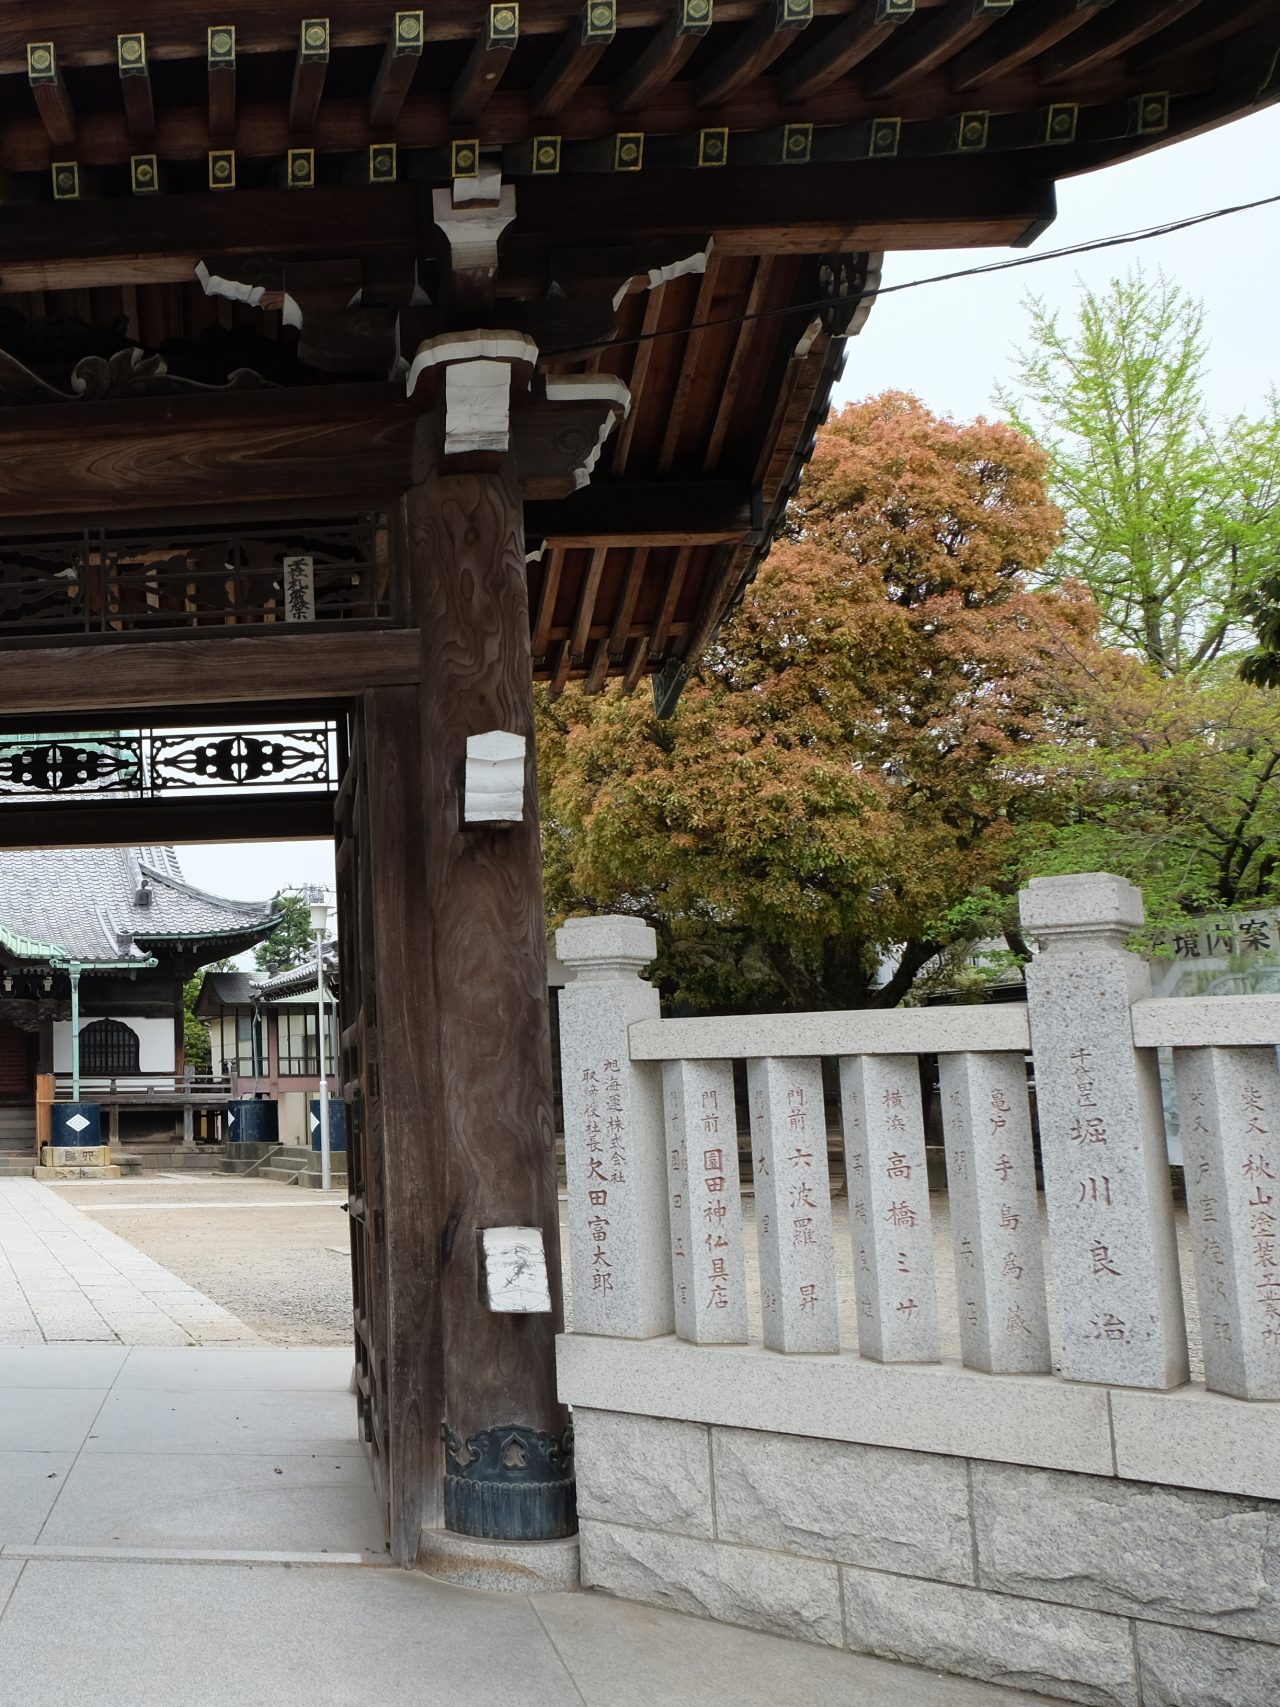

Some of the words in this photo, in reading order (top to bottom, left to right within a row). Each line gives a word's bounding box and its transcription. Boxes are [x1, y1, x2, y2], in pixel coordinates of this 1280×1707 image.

[603, 1058, 626, 1184] 旭海運株式会社
